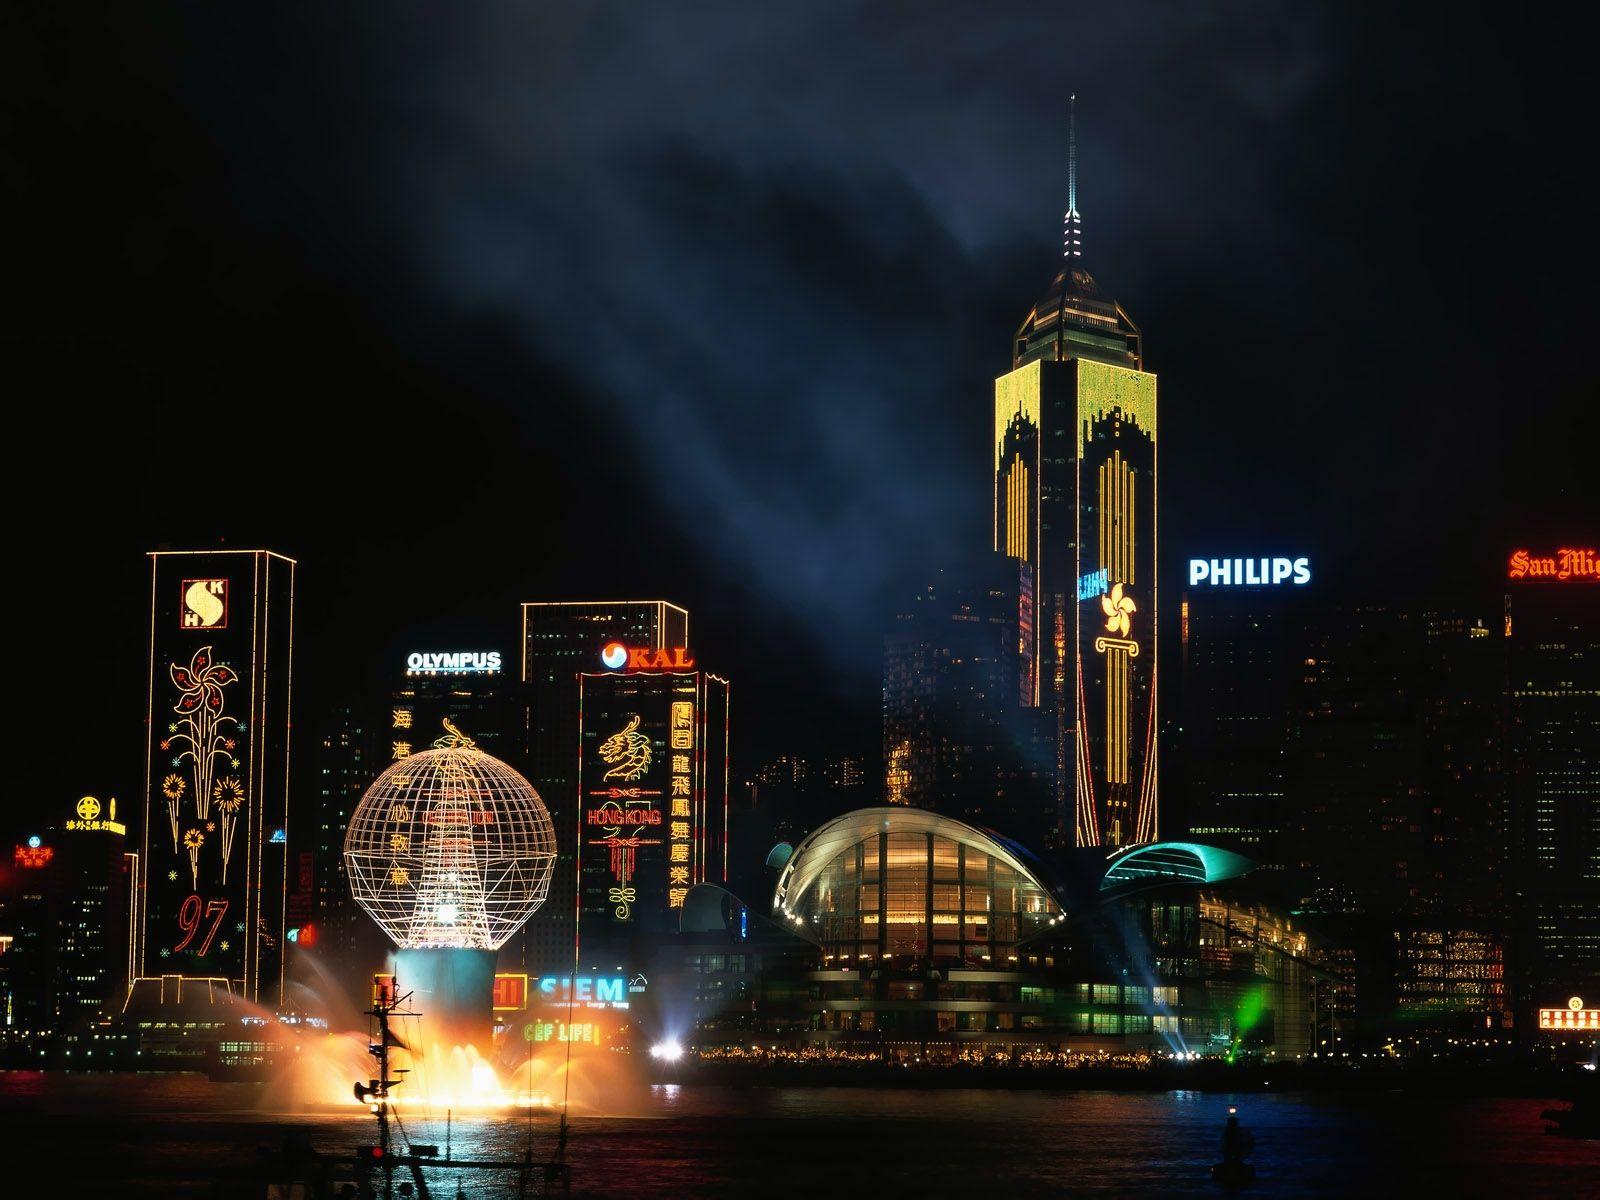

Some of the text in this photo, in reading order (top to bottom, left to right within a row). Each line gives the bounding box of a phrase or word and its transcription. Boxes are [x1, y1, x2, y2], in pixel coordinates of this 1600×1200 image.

[1189, 557, 1311, 586] PHILIPS
[1510, 551, 1557, 577] San
[407, 652, 502, 669] OLYMPUS
[628, 648, 694, 668] KAL
[587, 809, 662, 825] HONG KONG
[174, 895, 229, 957] 97
[558, 1023, 593, 1042] LIFE
